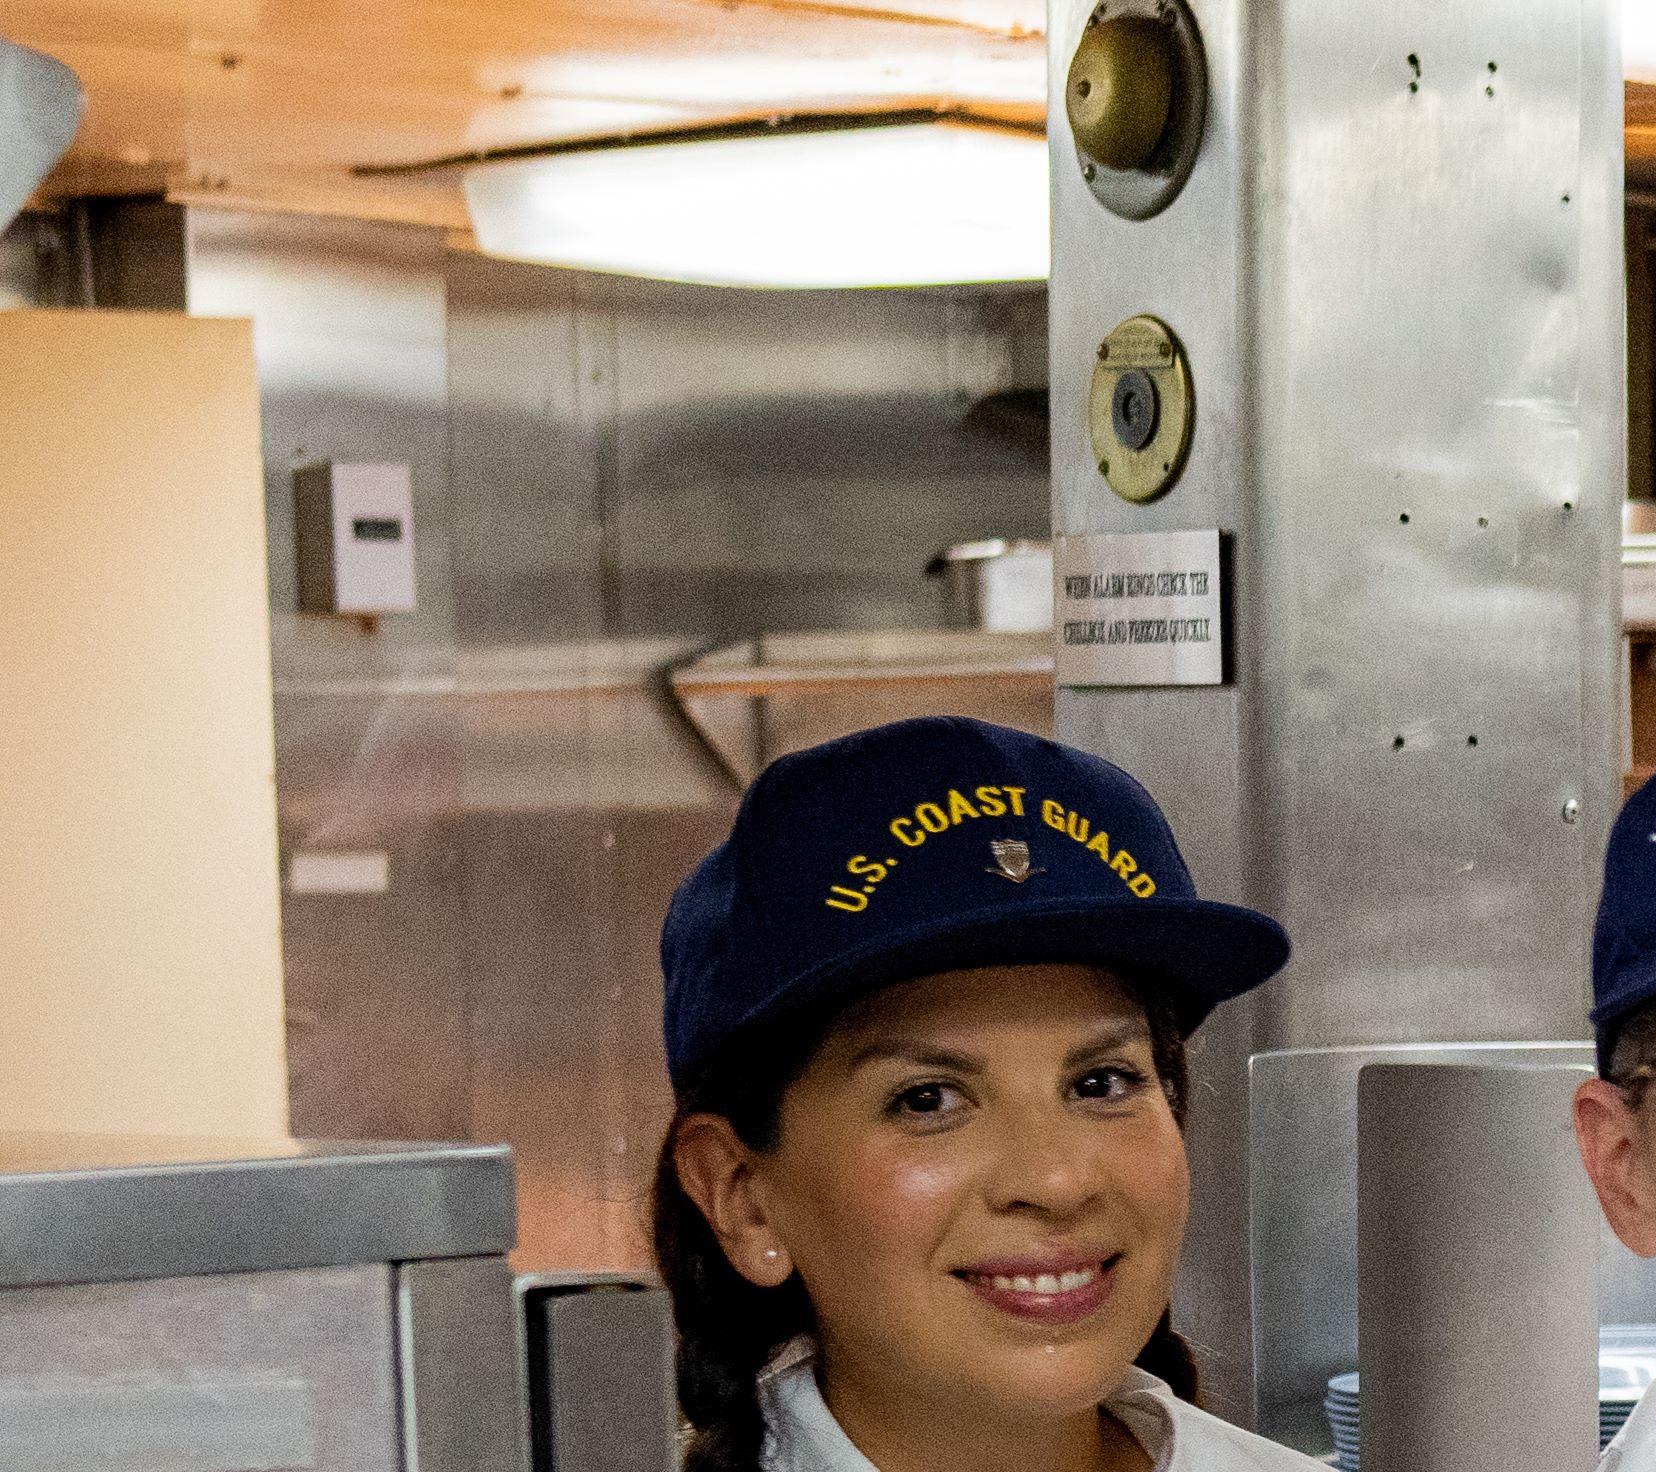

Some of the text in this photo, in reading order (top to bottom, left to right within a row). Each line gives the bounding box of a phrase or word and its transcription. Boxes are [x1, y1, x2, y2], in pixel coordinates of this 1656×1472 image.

[1092, 573, 1125, 599] ALARM
[1189, 571, 1210, 596] THE
[1107, 620, 1127, 645] AND
[825, 785, 1158, 912] U.S. COAST GUARD
